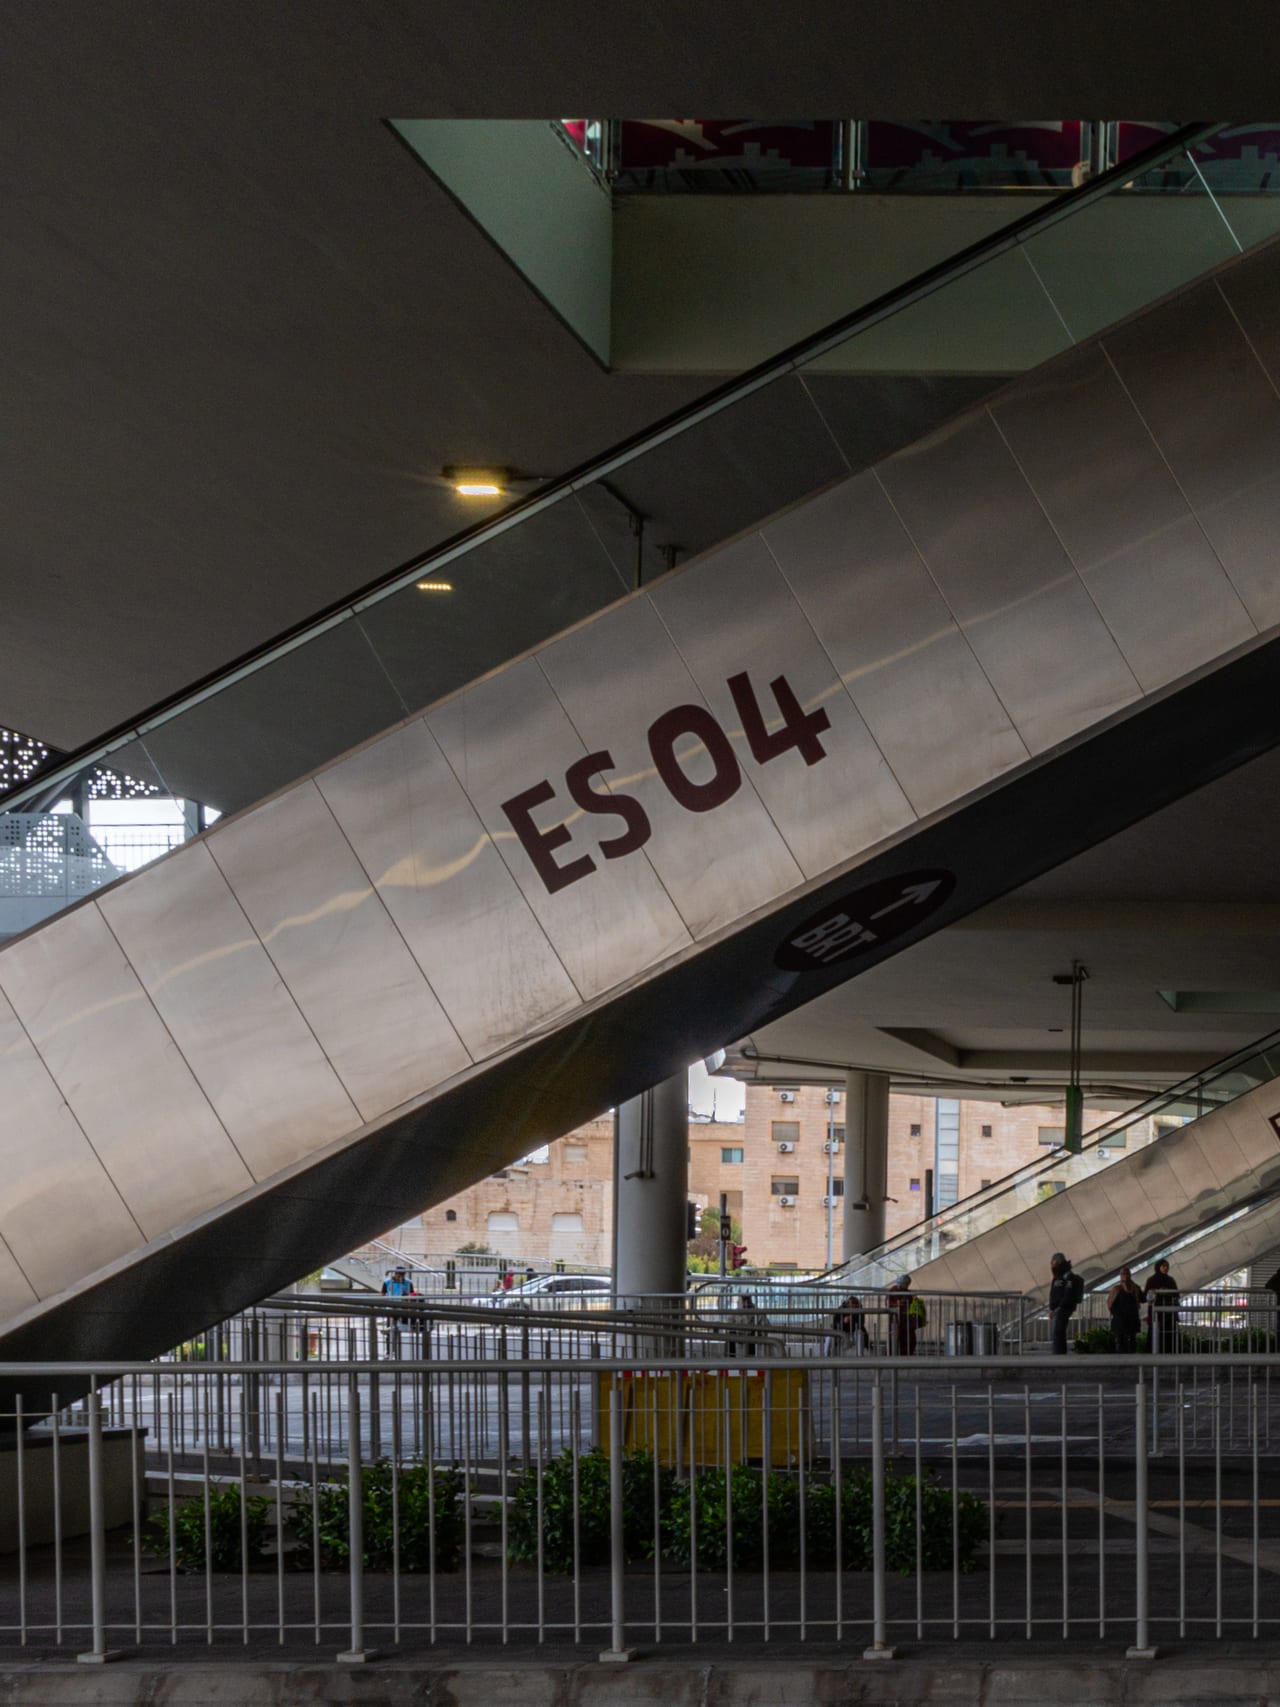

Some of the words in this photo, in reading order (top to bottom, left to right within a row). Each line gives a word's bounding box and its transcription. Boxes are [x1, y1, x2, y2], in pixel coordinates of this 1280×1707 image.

[501, 750, 651, 895] ES
[648, 671, 832, 813] 04
[790, 912, 879, 964] BRT
